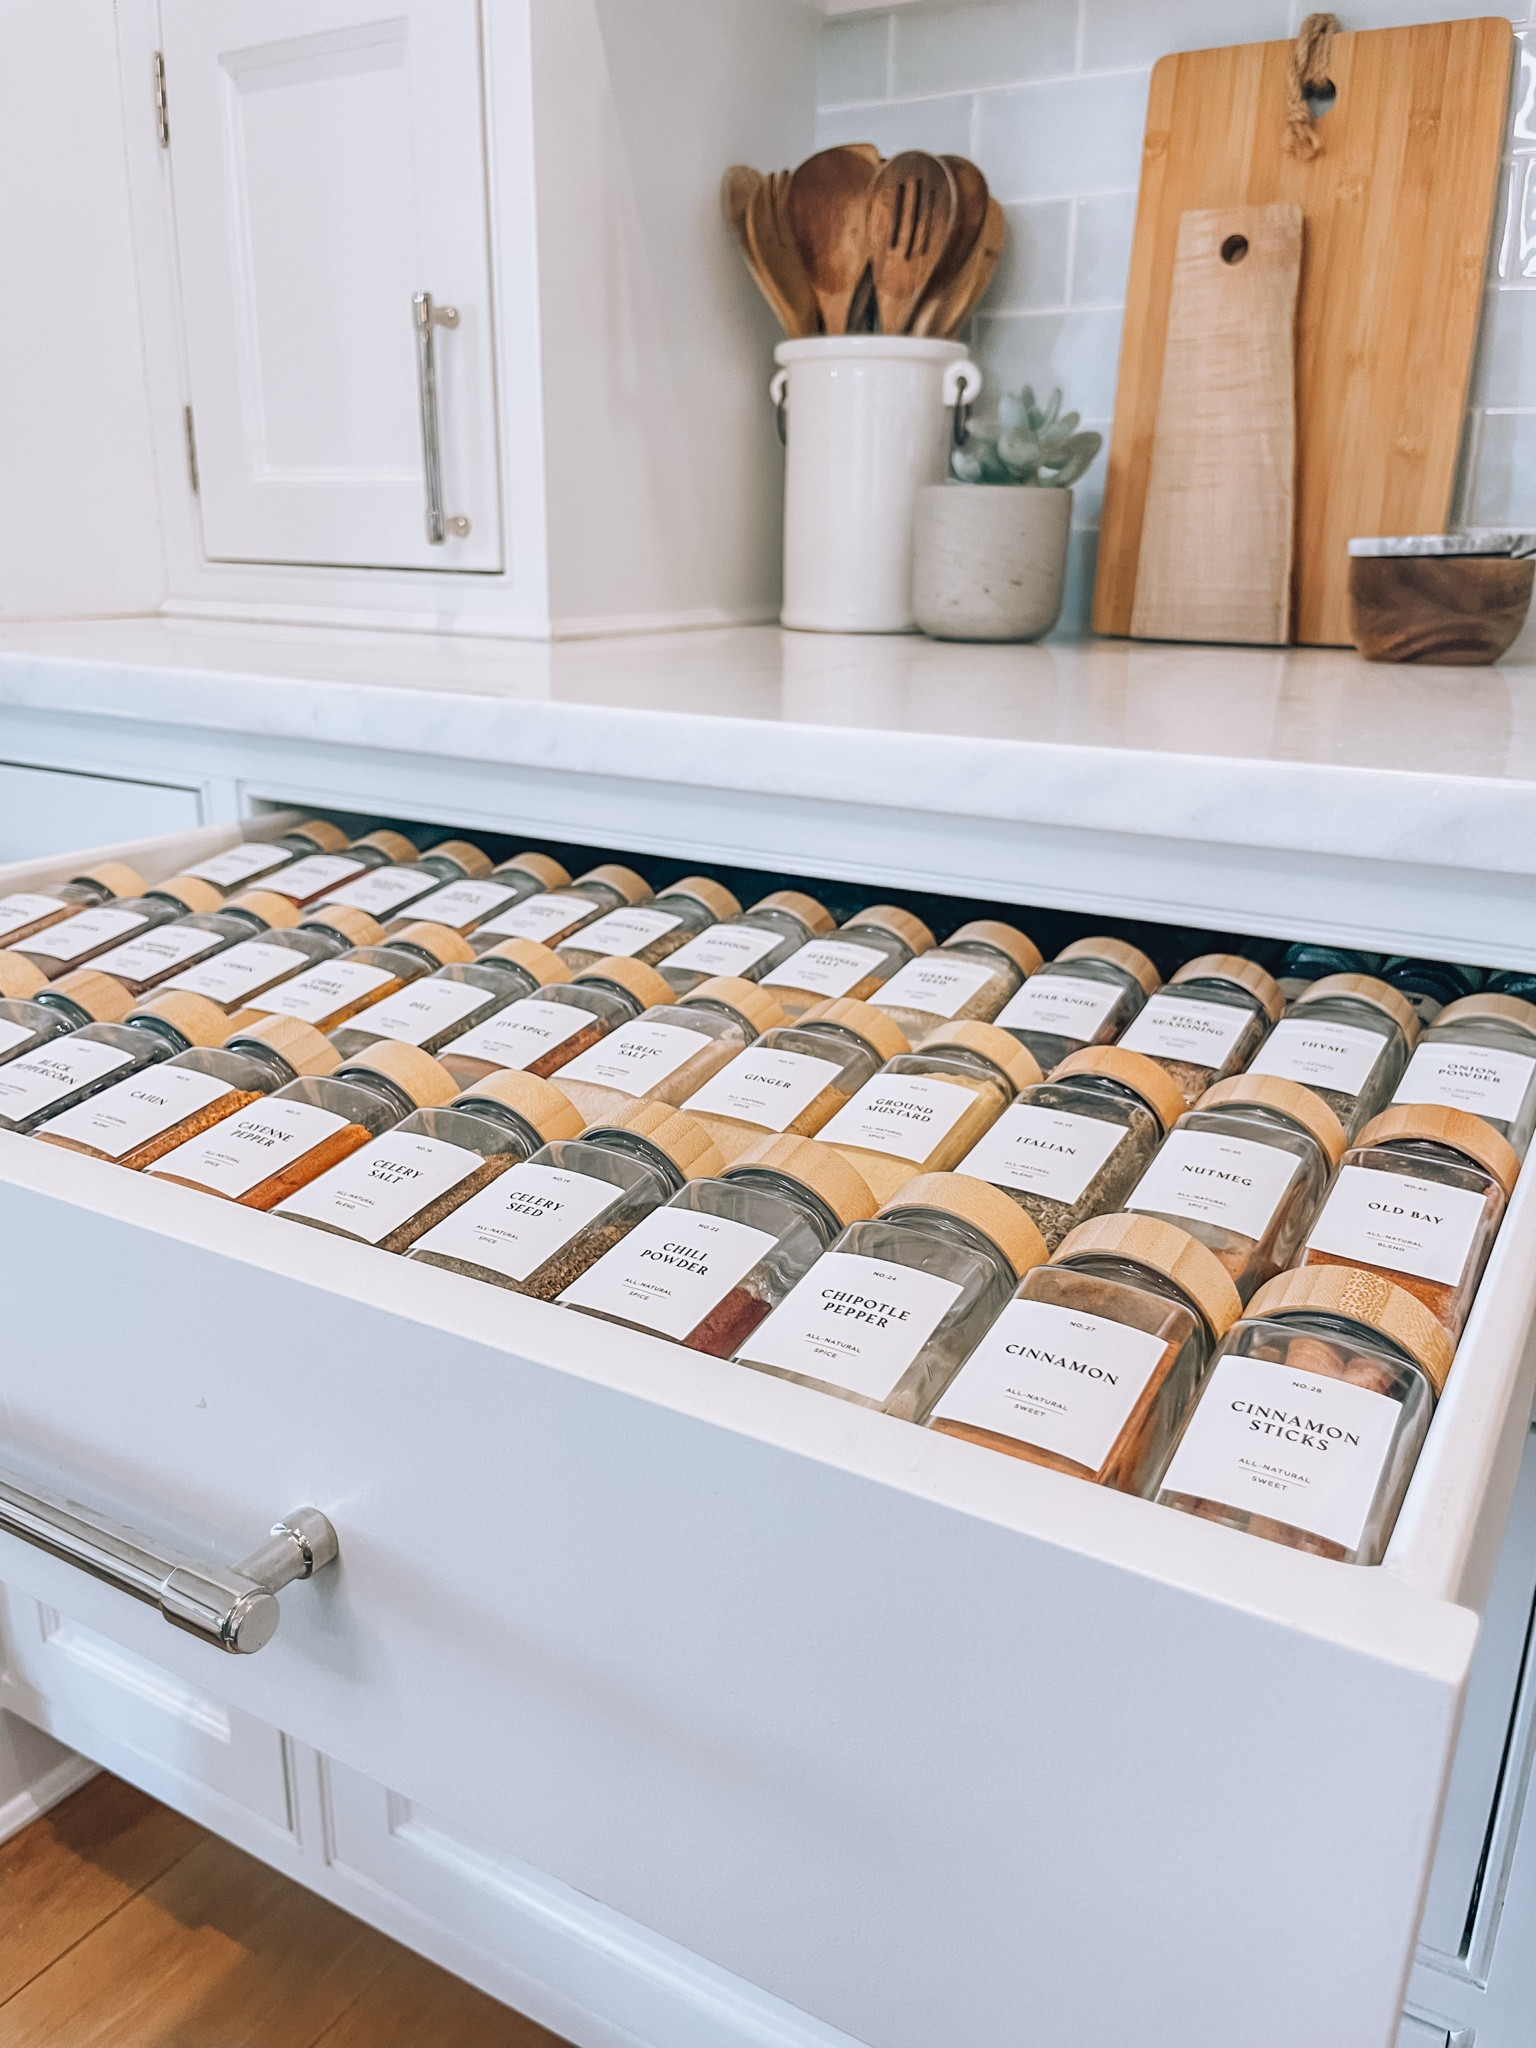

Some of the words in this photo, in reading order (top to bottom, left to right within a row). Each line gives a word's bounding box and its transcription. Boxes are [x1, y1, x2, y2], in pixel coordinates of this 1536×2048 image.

[1062, 997, 1097, 1008] ANISE
[1151, 1018, 1224, 1036] SEASONING
[1171, 1016, 1210, 1027] STEAK
[520, 1023, 553, 1037] SPICE
[618, 1049, 648, 1059] SALT
[620, 1042, 662, 1056] GARLIC
[1301, 1040, 1348, 1054] THYME
[39, 1060, 74, 1072] BLACK
[1447, 1063, 1498, 1076] ONION
[744, 1074, 792, 1089] GINGER
[1437, 1068, 1502, 1084] POWDER
[130, 1090, 168, 1106] CAJUN
[875, 1098, 934, 1114] GROUND
[865, 1105, 931, 1122] MUSTARD
[230, 1130, 276, 1147] PEPPER
[238, 1121, 295, 1142] CAYENNE
[1016, 1136, 1077, 1155] ITALIAN
[372, 1159, 424, 1179] CELERY
[1004, 1161, 1050, 1175] ALL-NATURAL
[1182, 1164, 1253, 1186] NUTMEG
[368, 1169, 404, 1185] SALT
[335, 1201, 356, 1210] BLEND
[336, 1190, 376, 1206] ALL-NATURAL
[509, 1192, 565, 1211] CELERY
[1176, 1192, 1228, 1206] ALL-NATURAL
[1187, 1202, 1209, 1210] SPICE
[506, 1202, 544, 1217] SEED
[1368, 1202, 1404, 1215] OLD
[1410, 1211, 1444, 1224] BAY
[476, 1224, 519, 1240] ALL-NATURAL
[698, 1224, 720, 1232] NO.22
[478, 1236, 498, 1244] SPICE
[1366, 1231, 1423, 1248] ALL-NATURAL
[1377, 1242, 1405, 1252] BLEND
[663, 1242, 709, 1261] CHILI
[640, 1250, 709, 1276] POWDER
[873, 1271, 897, 1281] NO.24
[624, 1278, 672, 1296] ALL-NATURAL
[628, 1291, 650, 1300] SPICE
[821, 1289, 911, 1321] CHIPOTLE
[822, 1302, 889, 1328] PEPPER
[1070, 1321, 1097, 1332] NO.27
[806, 1333, 861, 1353] ALL-NATURAL
[814, 1348, 838, 1358] SPICE
[1005, 1344, 1120, 1385] CINNAMON
[1292, 1381, 1322, 1393] NO.28
[1006, 1388, 1068, 1411] ALL-NATURAL
[1014, 1404, 1047, 1417] SWEET
[1231, 1400, 1361, 1446] CINNAMON
[1249, 1420, 1329, 1451] STICKS
[1238, 1458, 1311, 1483] ALL-NATURAL
[1251, 1476, 1288, 1491] SWEET
